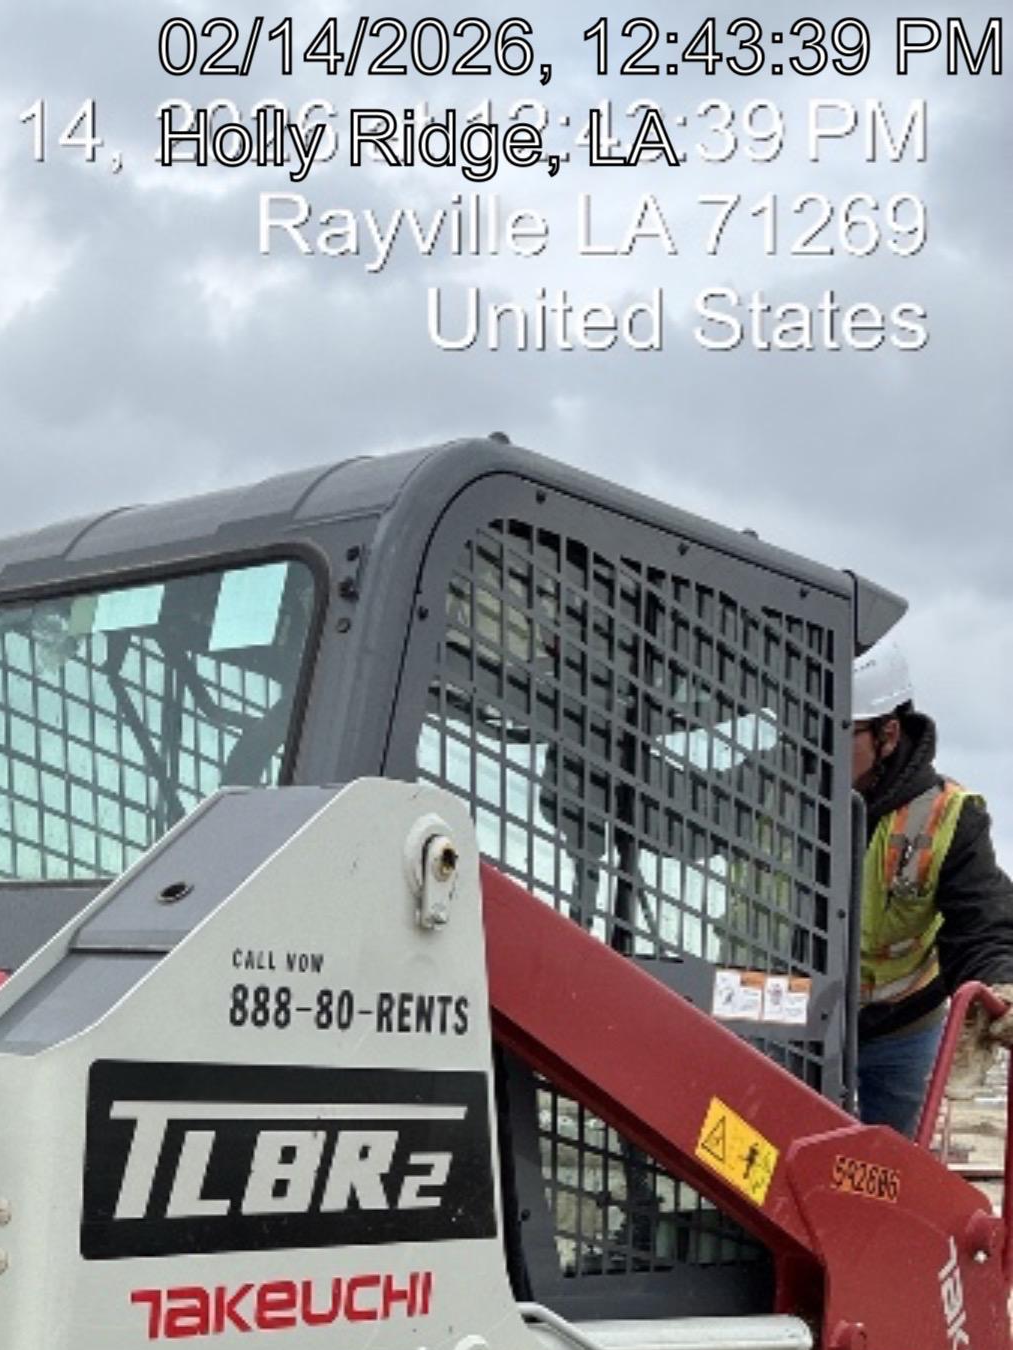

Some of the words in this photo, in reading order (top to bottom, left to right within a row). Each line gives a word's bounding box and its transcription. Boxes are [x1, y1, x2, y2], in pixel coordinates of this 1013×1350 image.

[232, 948, 276, 971] CALL
[287, 953, 324, 974] NOW
[229, 983, 469, 1036] 888-80-RENTS
